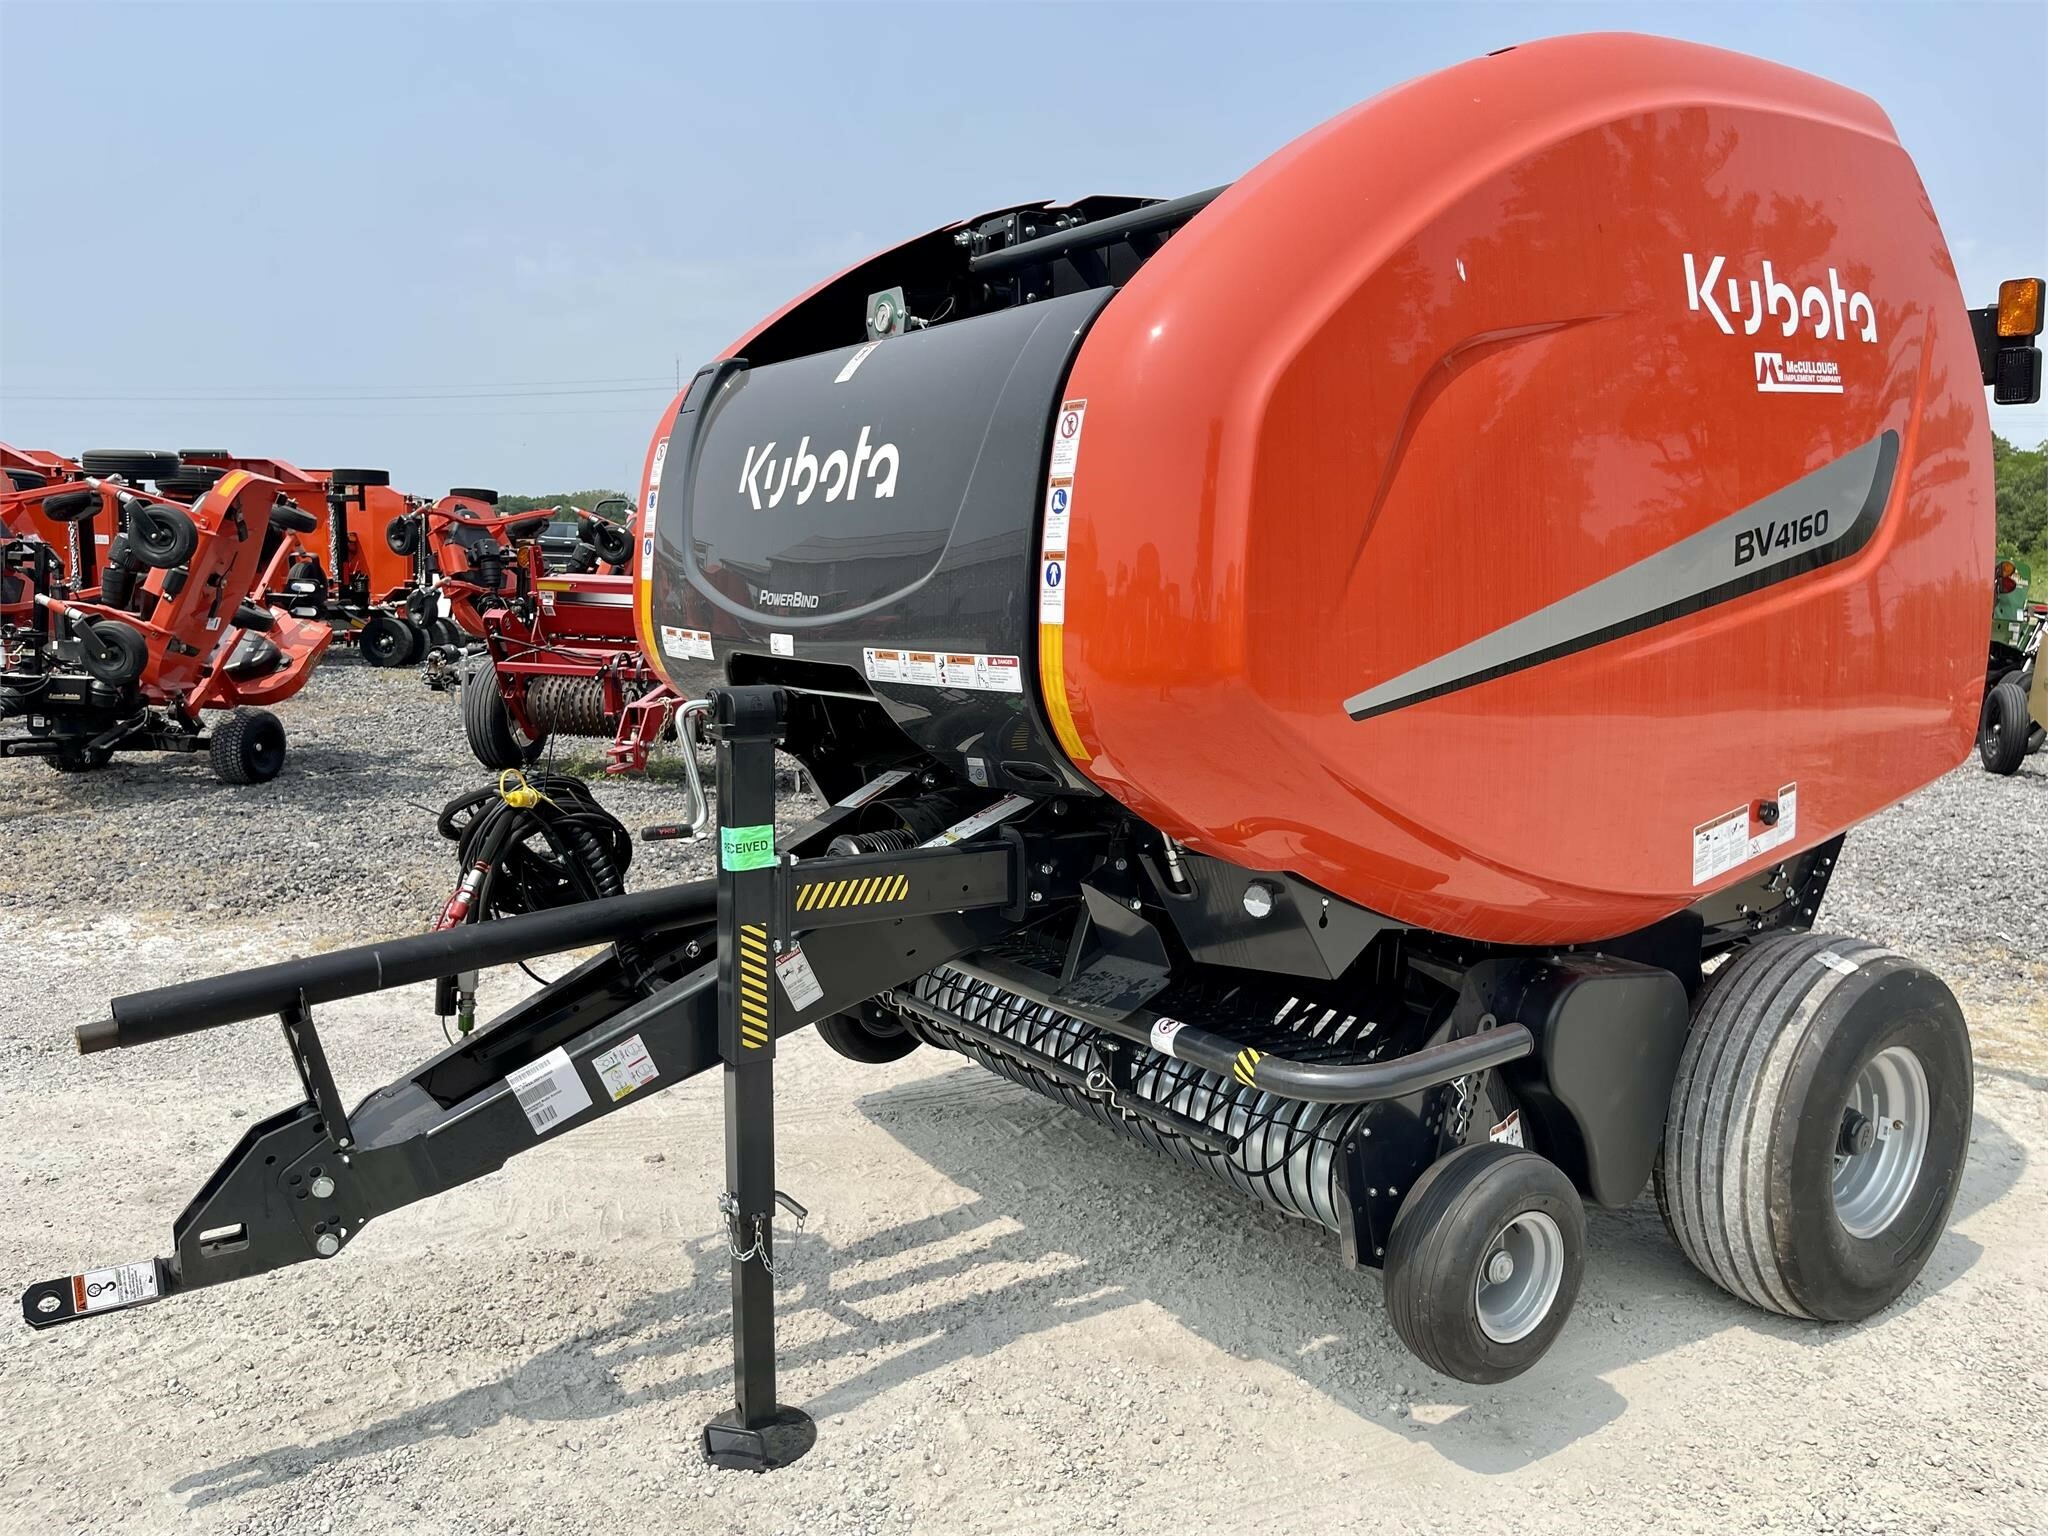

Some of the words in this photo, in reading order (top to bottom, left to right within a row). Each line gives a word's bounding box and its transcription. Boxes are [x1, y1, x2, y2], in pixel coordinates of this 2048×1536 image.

[1682, 253, 1877, 343] Kubota
[738, 425, 899, 510] Kubota
[1734, 509, 1828, 567] BV4160
